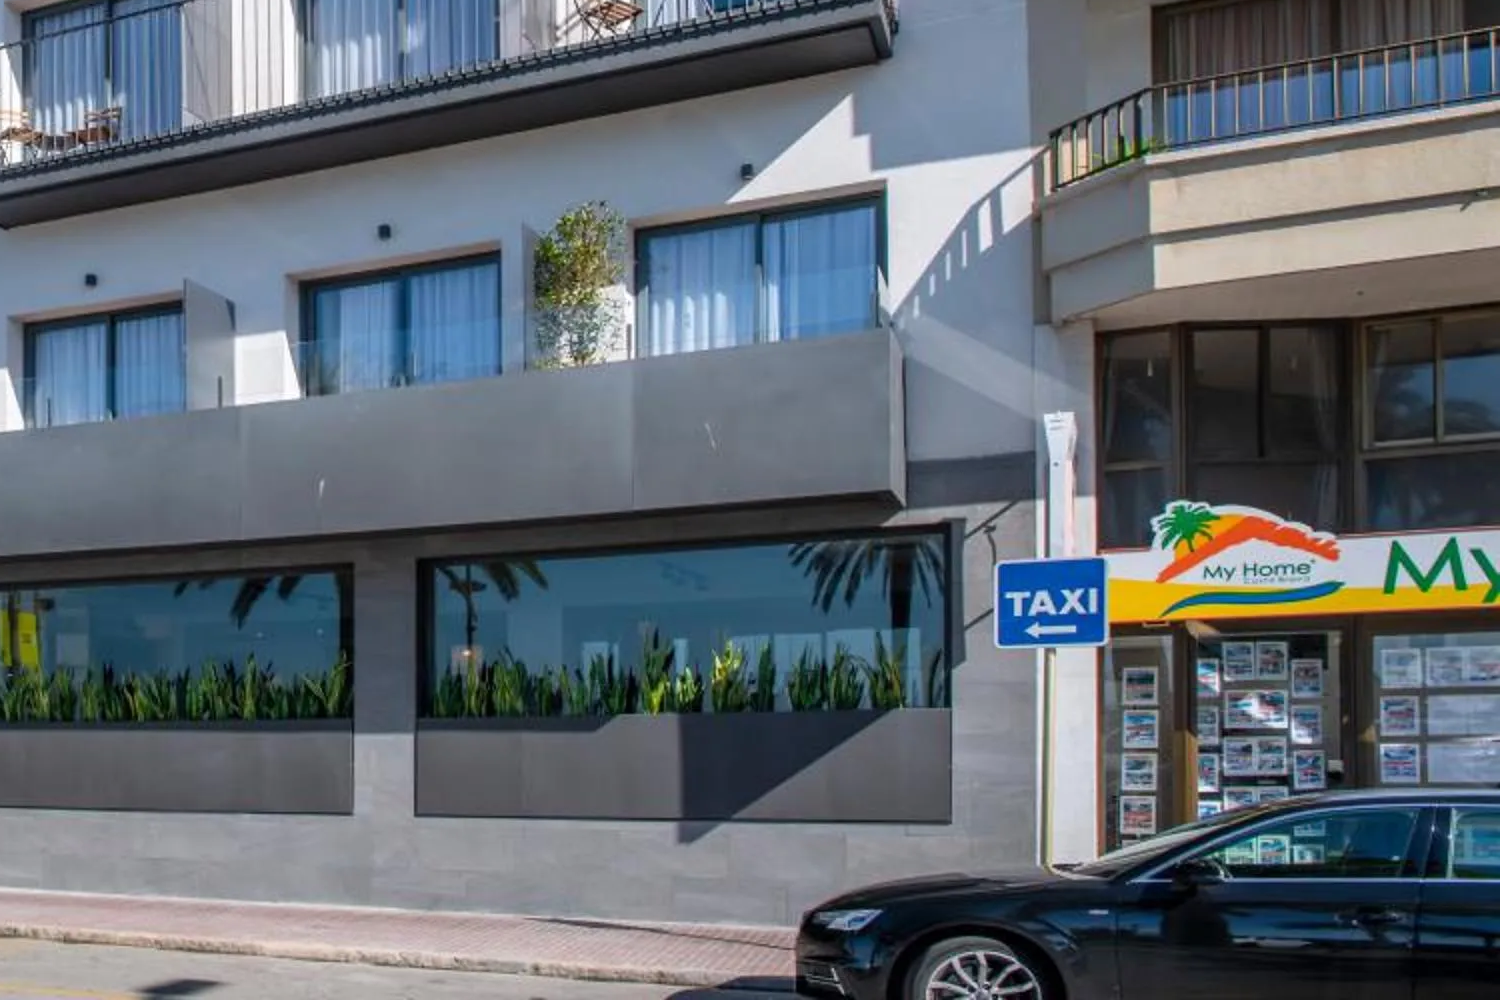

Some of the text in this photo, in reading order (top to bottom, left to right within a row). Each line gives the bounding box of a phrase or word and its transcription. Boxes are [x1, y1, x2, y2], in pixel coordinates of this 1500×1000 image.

[1203, 563, 1312, 581] My Home
[1005, 587, 1098, 617] TAXI
